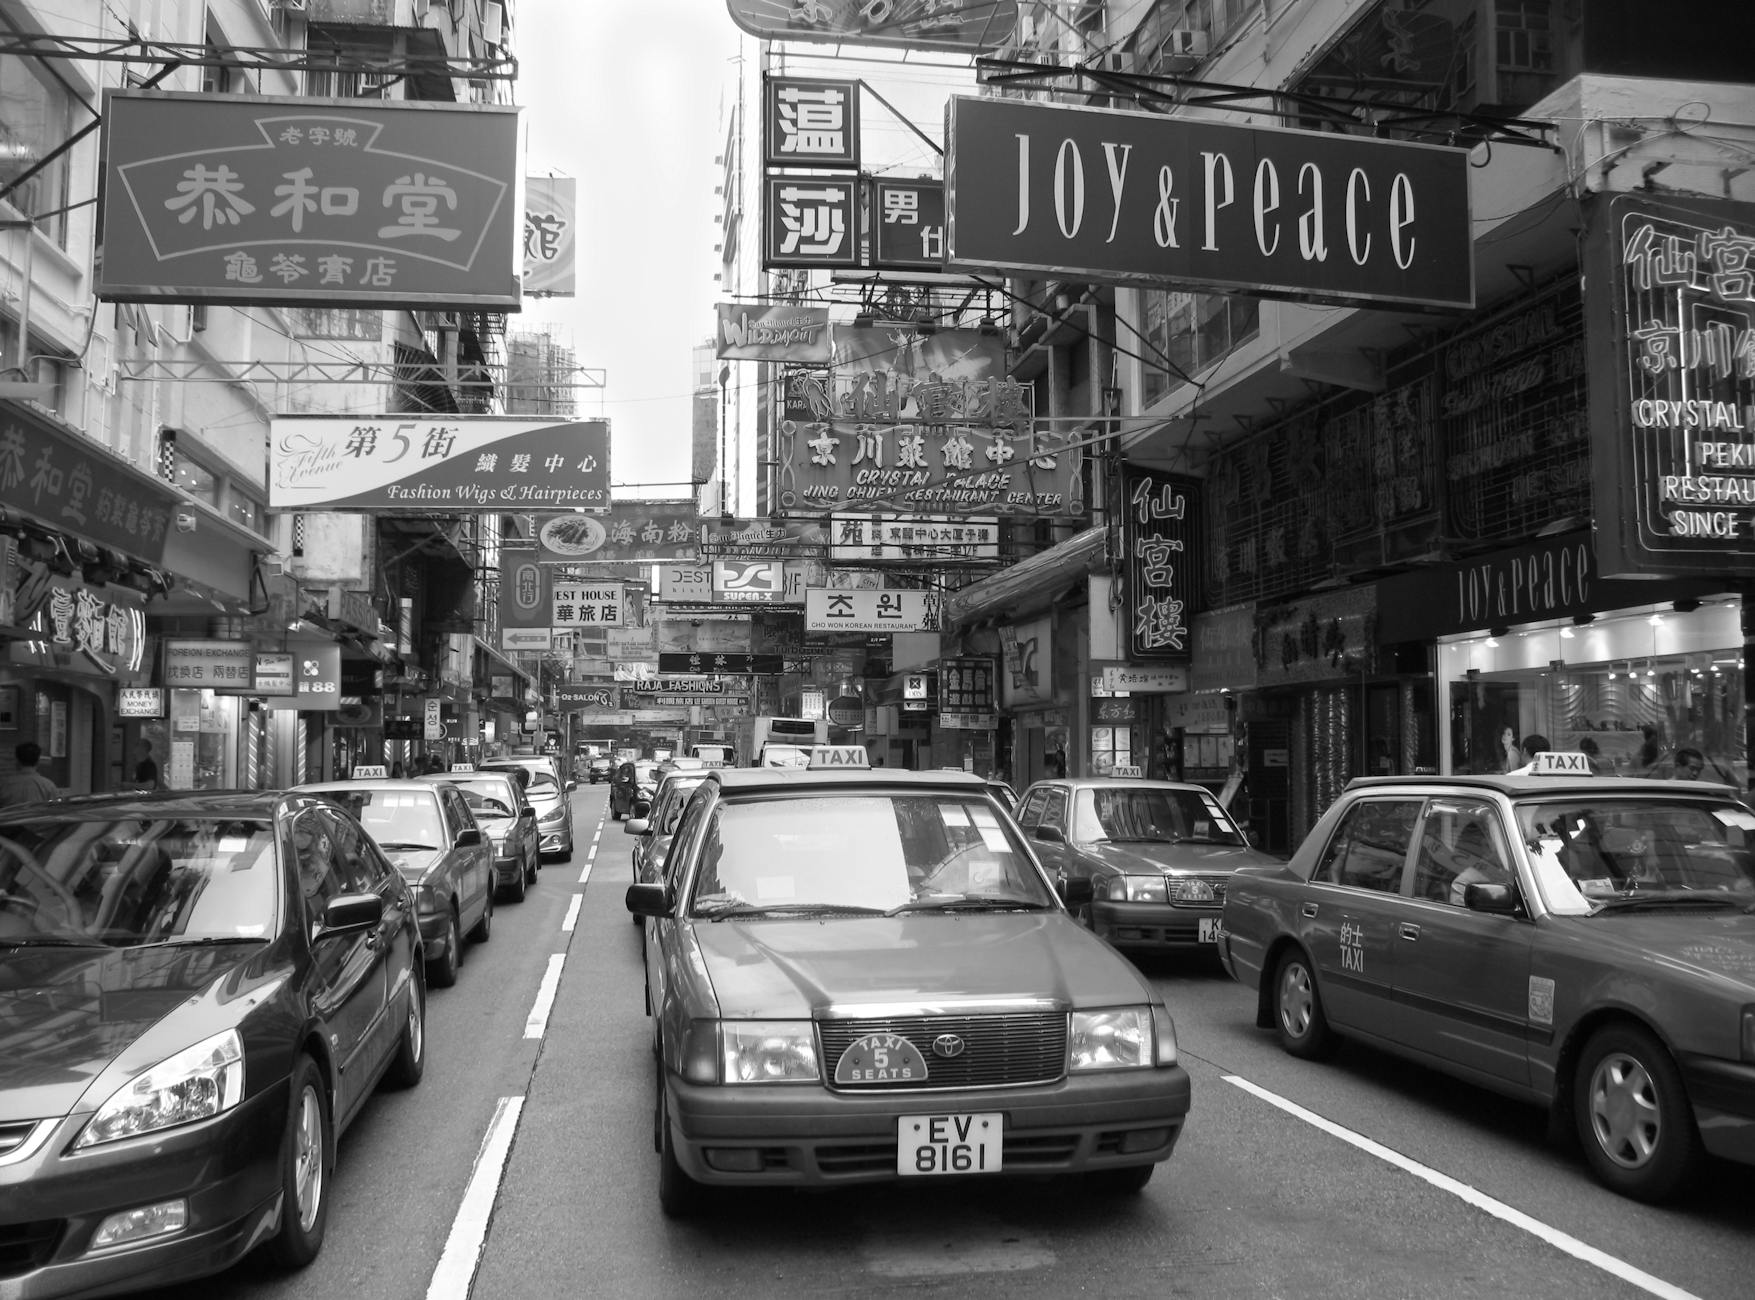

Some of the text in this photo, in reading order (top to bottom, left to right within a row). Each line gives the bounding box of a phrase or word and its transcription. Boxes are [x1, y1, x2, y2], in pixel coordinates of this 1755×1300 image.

[279, 125, 359, 148] 老字號
[164, 164, 464, 243] 恭和堂
[1153, 165, 1180, 249] &
[223, 251, 398, 286] 龜苓膏店
[1634, 399, 1744, 430] CRYSTAL
[343, 424, 458, 463] 第5街
[388, 484, 603, 505] Fashion Wigs & Hairpieces
[803, 484, 839, 498] JING
[1670, 510, 1739, 538] SINCE
[1133, 477, 1187, 649] 仙宮樓
[581, 591, 617, 600] HOUSE
[826, 593, 903, 619] 조원
[557, 605, 618, 622] 華旅店
[845, 622, 873, 630] KOREAN
[637, 680, 721, 692] RAJA FASHIONS
[817, 750, 863, 765] TAXI
[1545, 755, 1586, 770] TAXI
[357, 768, 383, 777] TAXI
[1116, 767, 1139, 777] TAXI
[1191, 886, 1199, 895] 5
[1340, 922, 1363, 947] 的士
[1340, 945, 1363, 973] TAXI
[859, 1036, 904, 1051] TAXI
[873, 1048, 889, 1069] 5
[852, 1067, 912, 1080] SEATS
[929, 1116, 972, 1143] EV
[915, 1143, 985, 1172] 8161
